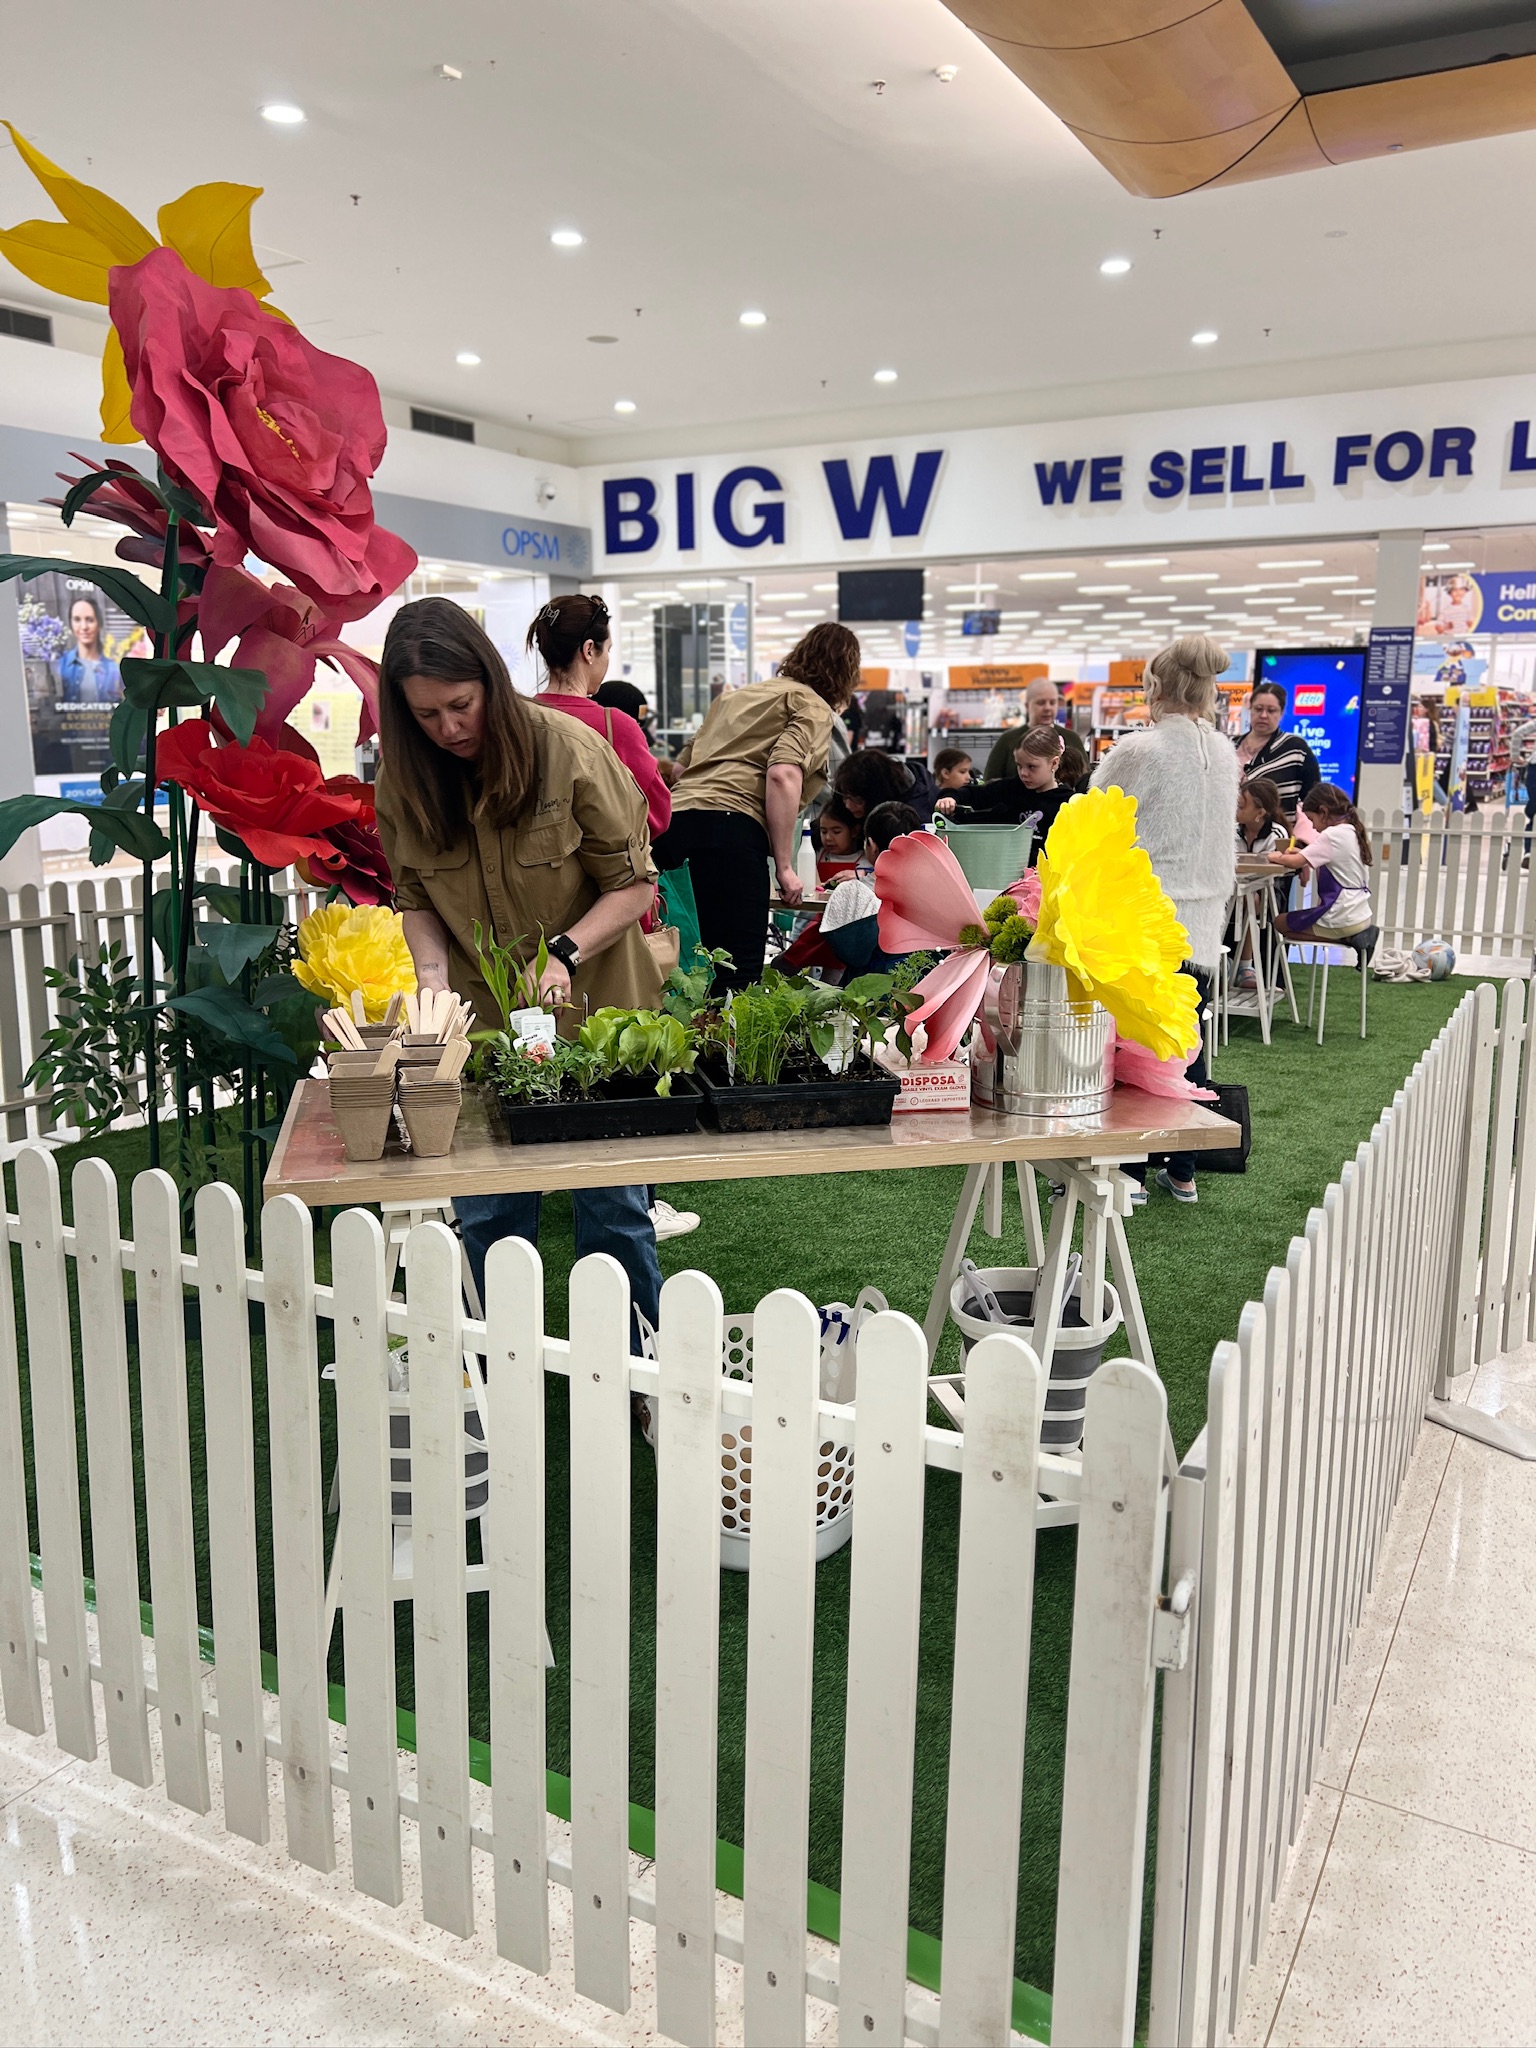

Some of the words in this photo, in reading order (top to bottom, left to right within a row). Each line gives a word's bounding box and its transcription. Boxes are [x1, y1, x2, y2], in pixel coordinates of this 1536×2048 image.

[1034, 456, 1123, 505] WE
[1148, 441, 1305, 499] SELL
[1333, 427, 1476, 486] FOR
[603, 466, 785, 555] BIG
[822, 450, 944, 541] W
[502, 528, 560, 562] OPSM
[65, 579, 94, 591] OPSM
[55, 702, 112, 711] DEDICATED
[1296, 692, 1325, 707] LEGO
[66, 712, 112, 721] EVERYDA
[1293, 722, 1326, 738] Live
